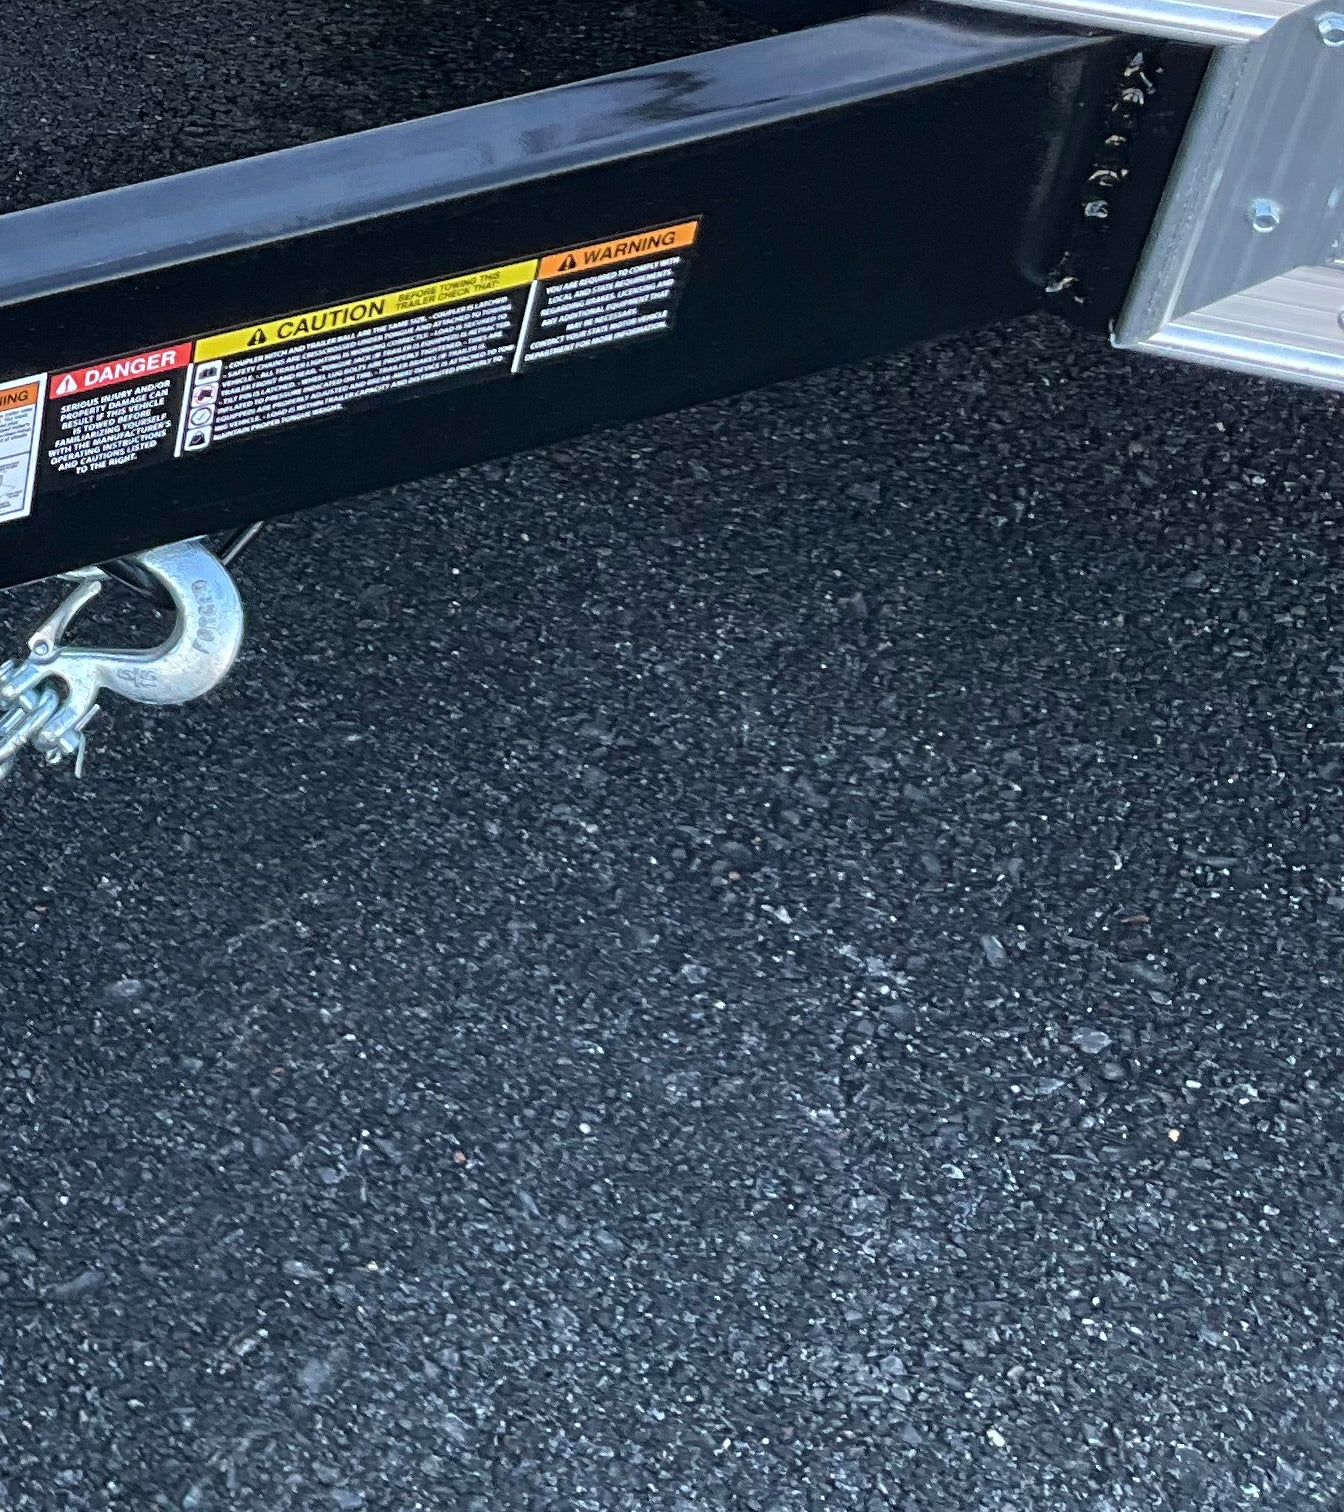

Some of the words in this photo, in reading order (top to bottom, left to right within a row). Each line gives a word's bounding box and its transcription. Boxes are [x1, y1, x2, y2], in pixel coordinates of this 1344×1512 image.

[584, 229, 675, 265] WARNING
[479, 270, 500, 282] THIS
[396, 294, 434, 311] TRAILER
[276, 298, 384, 340] CAUTION
[84, 349, 176, 386] DANGER
[60, 397, 98, 413] SERIOUS
[100, 388, 132, 403] INJURY
[60, 403, 106, 422] PROPERTY
[108, 393, 146, 410] DAMAGE
[148, 388, 168, 400] CAN
[61, 414, 93, 430] RESULT
[96, 412, 104, 421] IF
[106, 407, 125, 419] THIS
[128, 397, 164, 413] VEHICLE
[73, 426, 81, 435] IS
[84, 417, 115, 432] TOWED
[117, 409, 150, 424] BEFORE
[123, 412, 166, 431] YOURSELF
[48, 444, 71, 457] WITH
[74, 439, 90, 451] THE
[50, 445, 100, 465] OPERATING
[102, 429, 166, 452] INSTRUCTIONS
[58, 459, 77, 471] AND
[80, 447, 124, 466] CAUTIONS
[127, 439, 157, 454] LISTED
[76, 464, 87, 474] TO
[90, 460, 105, 470] THE
